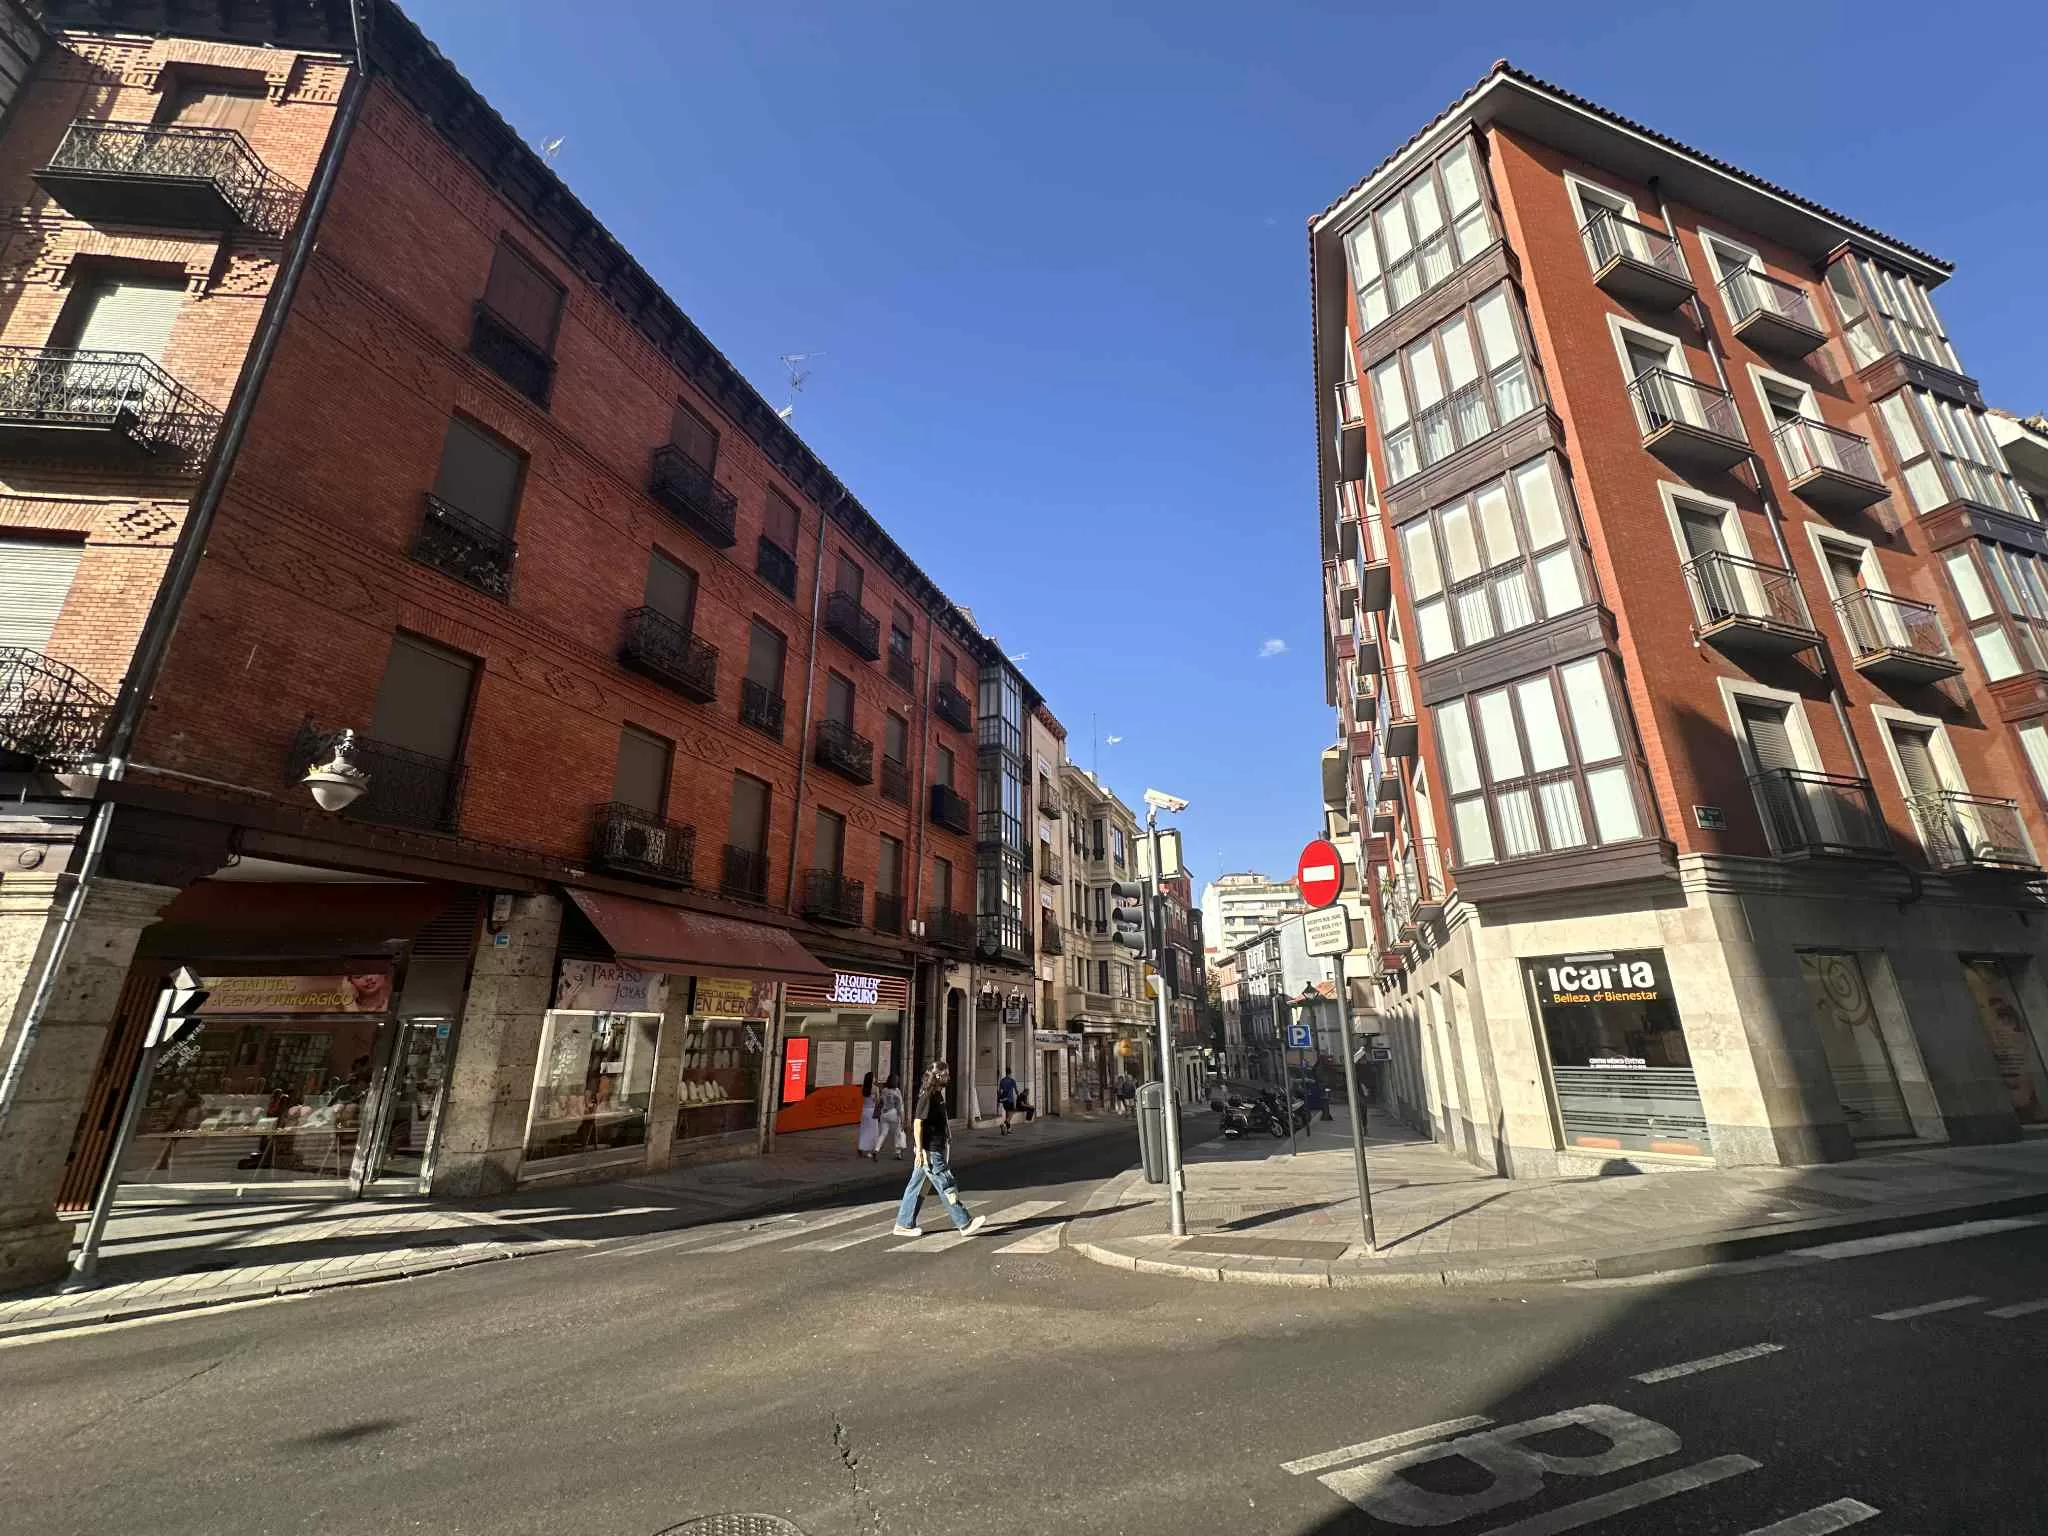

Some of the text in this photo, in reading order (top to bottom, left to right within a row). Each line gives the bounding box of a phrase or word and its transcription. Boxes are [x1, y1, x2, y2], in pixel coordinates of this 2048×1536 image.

[838, 974, 879, 990] ALQUILER
[838, 986, 878, 1004] SEGURO
[1553, 994, 1591, 1004] Belleza
[1605, 991, 1658, 1002] Bienestar
[695, 997, 753, 1014] EN ACERO
[1293, 1027, 1306, 1045] P
